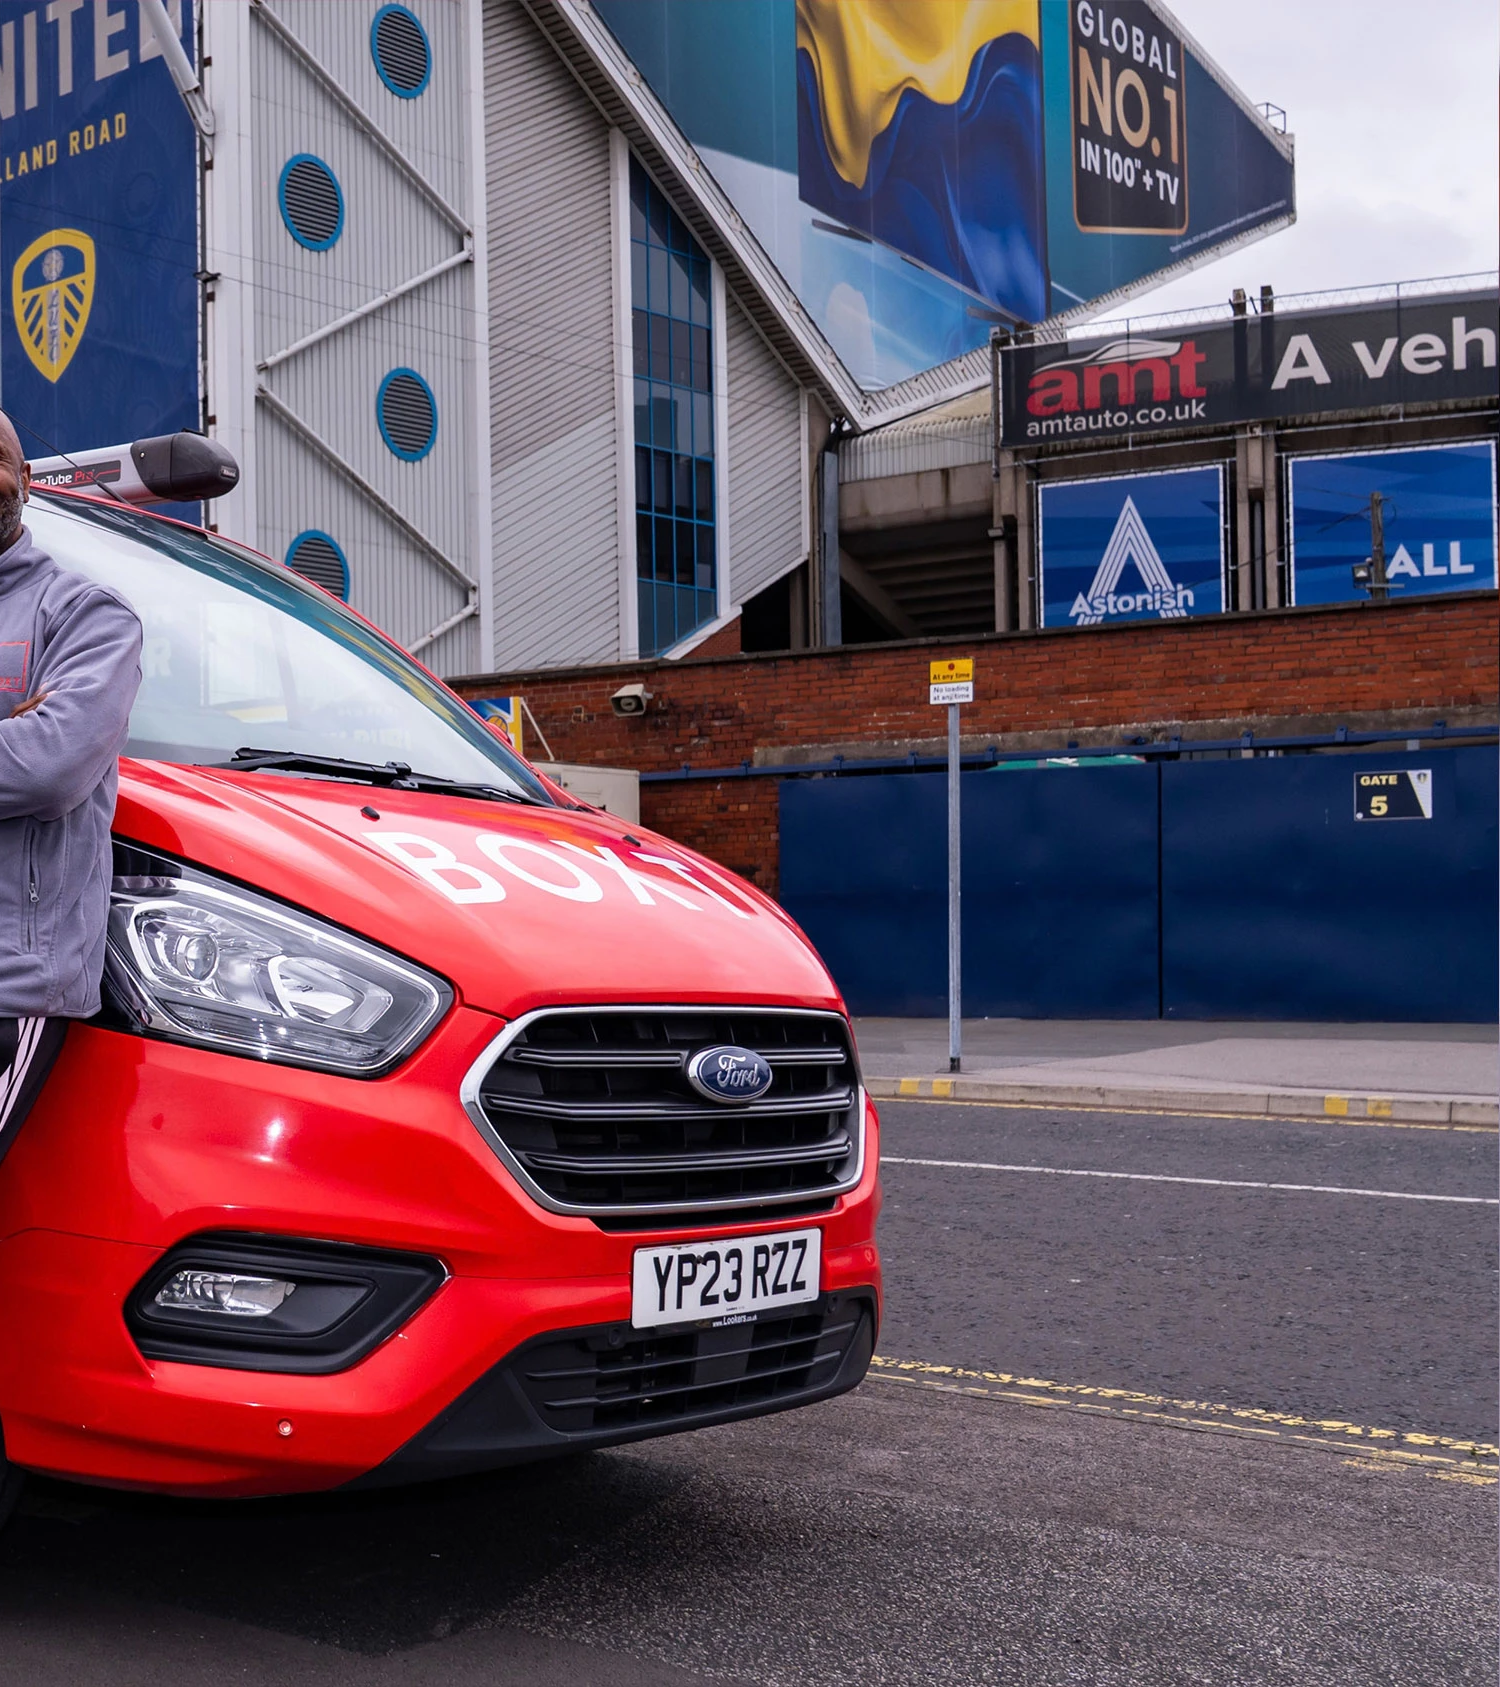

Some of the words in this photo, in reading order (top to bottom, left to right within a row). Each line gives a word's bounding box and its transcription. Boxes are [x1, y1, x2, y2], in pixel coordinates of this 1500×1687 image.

[1077, 0, 1177, 79] GLOBAL
[1078, 46, 1179, 164] NO.1
[69, 112, 127, 156] ROAD
[1080, 138, 1100, 175] IN
[1155, 169, 1179, 205] TV
[1270, 334, 1332, 390] A
[1352, 316, 1497, 380] veh
[1026, 340, 1207, 417] amt
[1026, 399, 1206, 438] amtauto.co.uk
[74, 471, 93, 482] Pro
[1385, 540, 1475, 579] ALL
[1069, 583, 1195, 618] Astonish
[1360, 775, 1398, 786] GATE
[1370, 795, 1388, 816] 5
[361, 831, 753, 920] BOXT
[717, 1055, 760, 1088] Ford
[653, 1248, 743, 1312] YP23
[752, 1238, 808, 1299] RZZ
